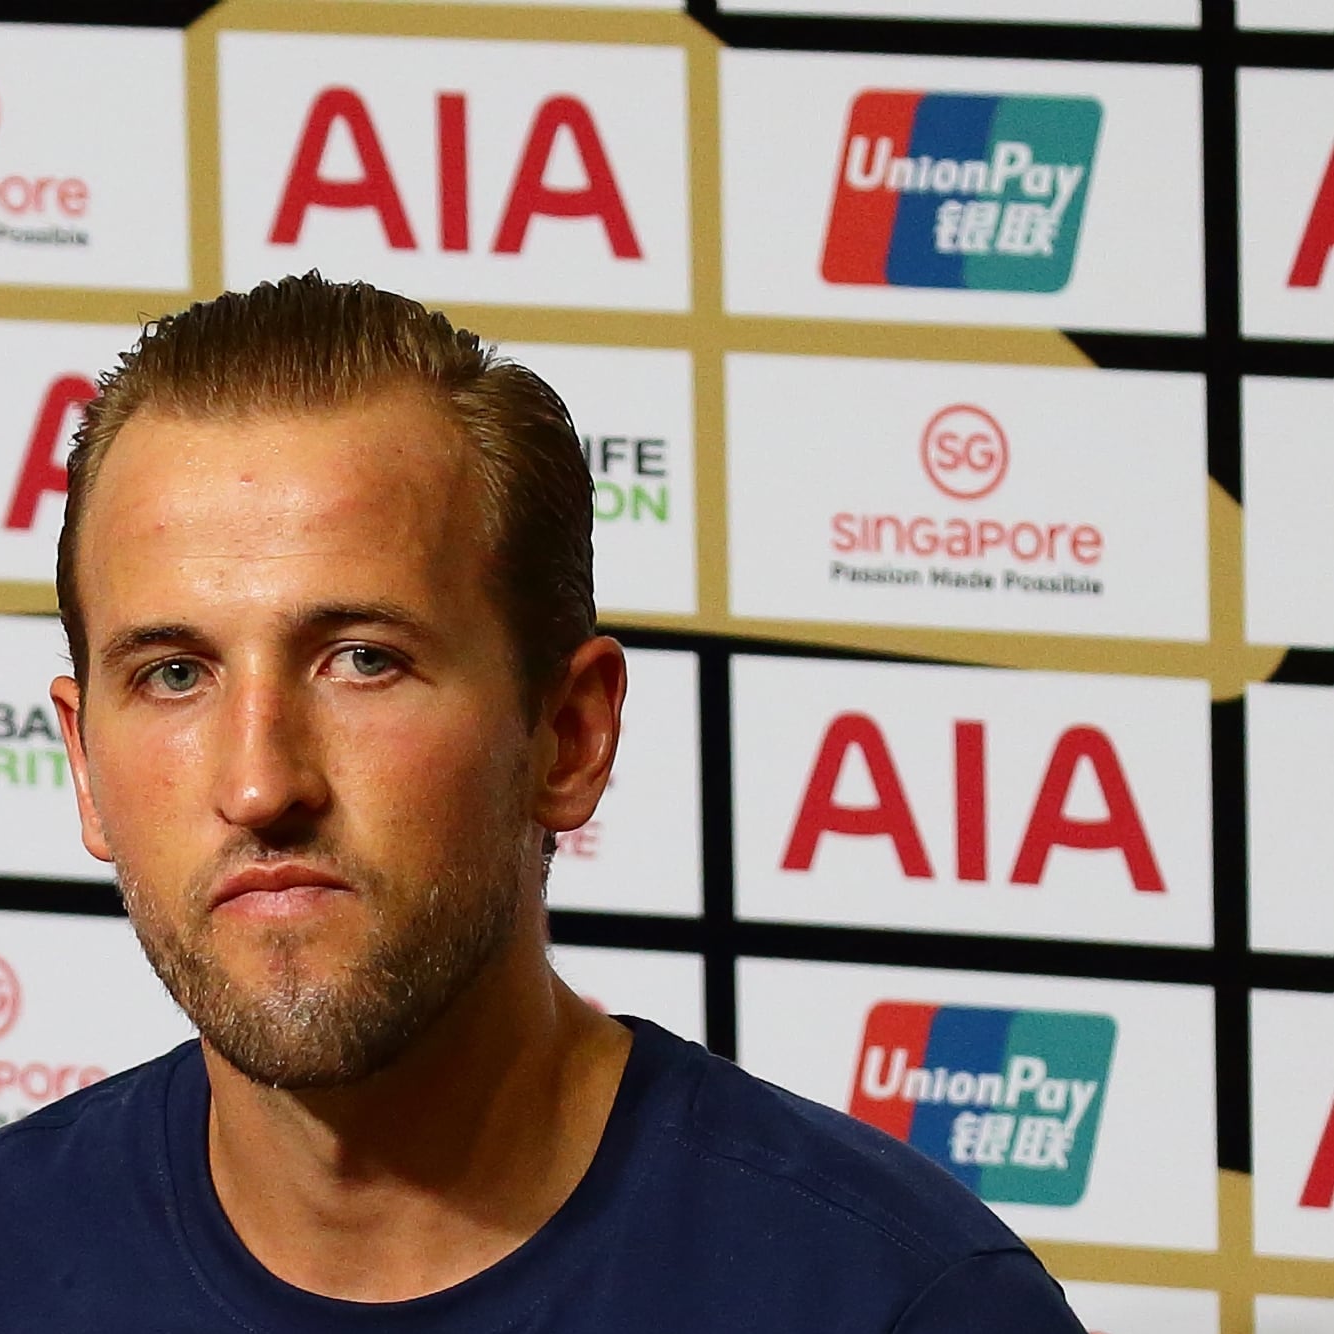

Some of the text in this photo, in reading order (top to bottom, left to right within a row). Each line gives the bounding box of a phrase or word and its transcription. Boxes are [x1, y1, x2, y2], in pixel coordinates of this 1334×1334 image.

[267, 86, 647, 262] AIA
[845, 137, 1083, 214] UnionPay
[933, 201, 1056, 256] 银联
[935, 431, 996, 473] SG
[591, 480, 670, 521] ON
[830, 561, 1105, 596] Passion Made Possible
[780, 711, 1169, 894] AIA
[860, 1046, 1097, 1131] UnionPay
[950, 1114, 1071, 1169] 银联
